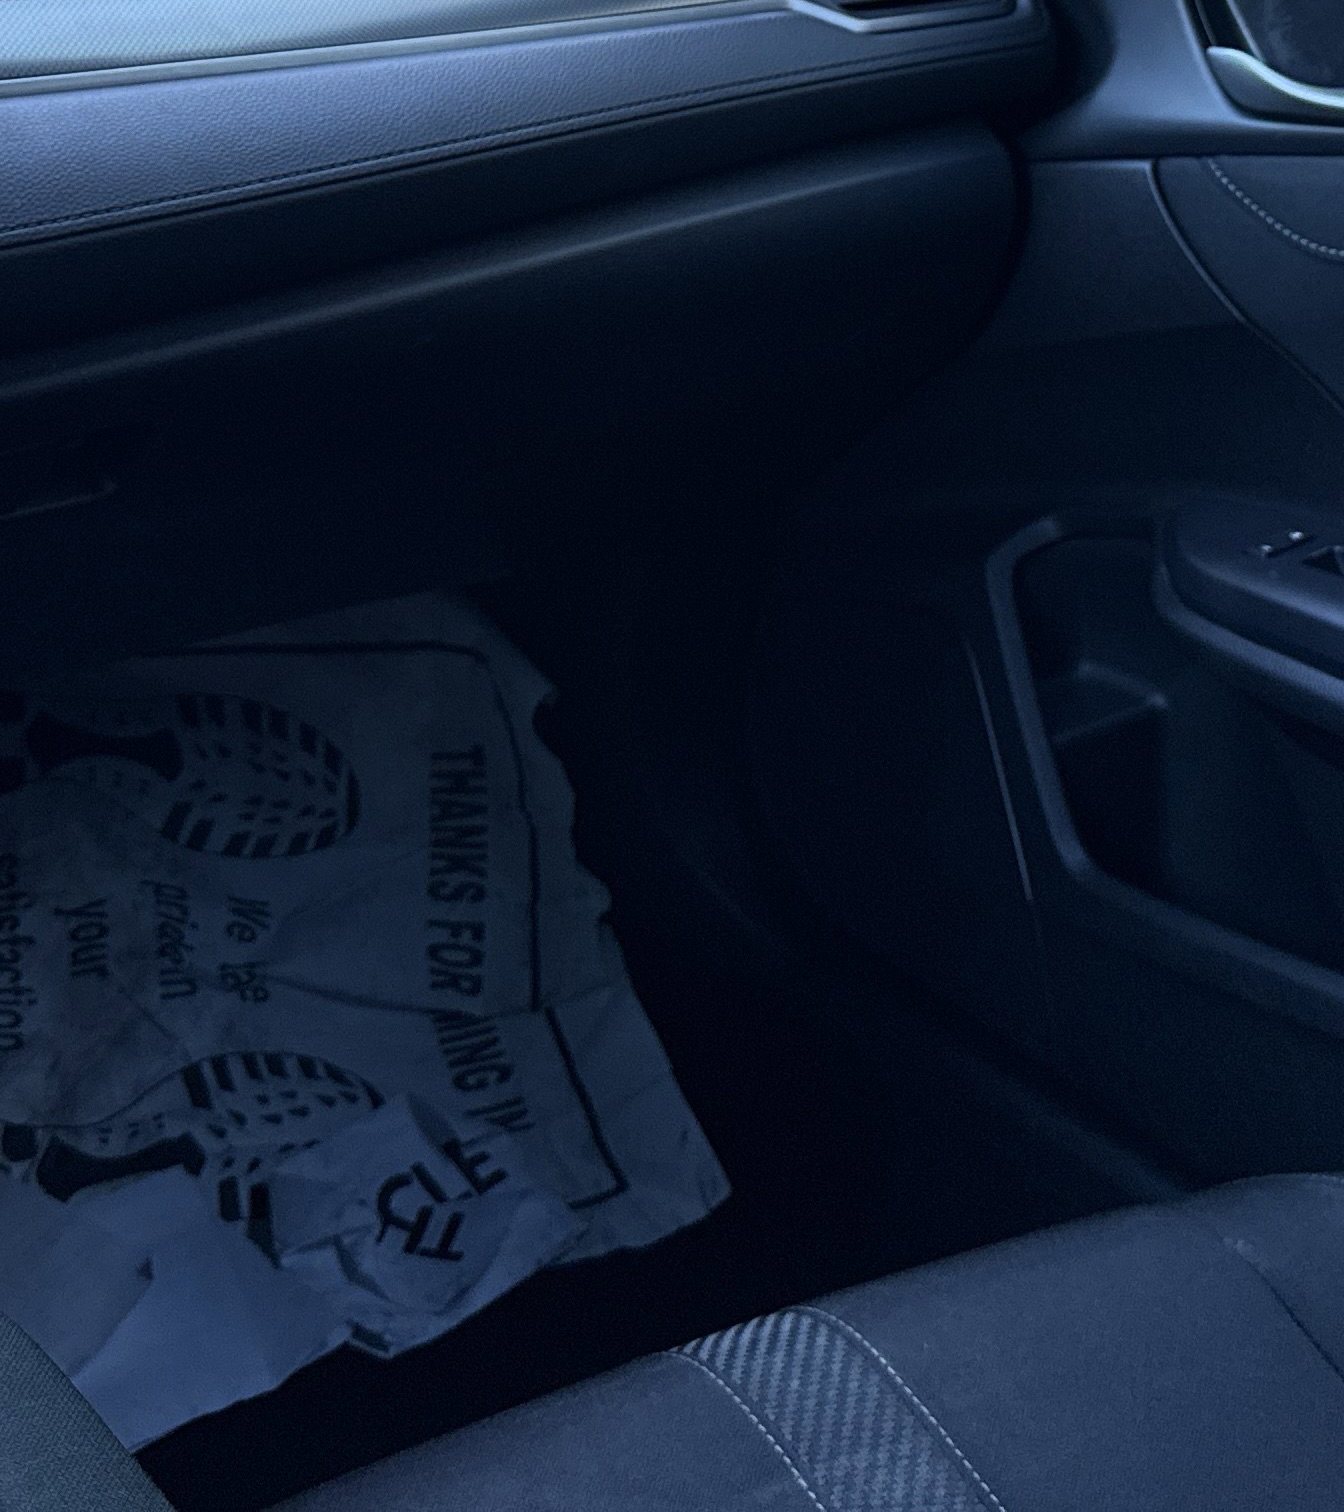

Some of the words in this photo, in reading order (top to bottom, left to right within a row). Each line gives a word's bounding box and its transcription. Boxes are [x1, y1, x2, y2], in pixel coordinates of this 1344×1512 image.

[426, 744, 487, 903] THANKS
[52, 897, 110, 981] your
[224, 895, 271, 943] We
[425, 919, 487, 997] FOR
